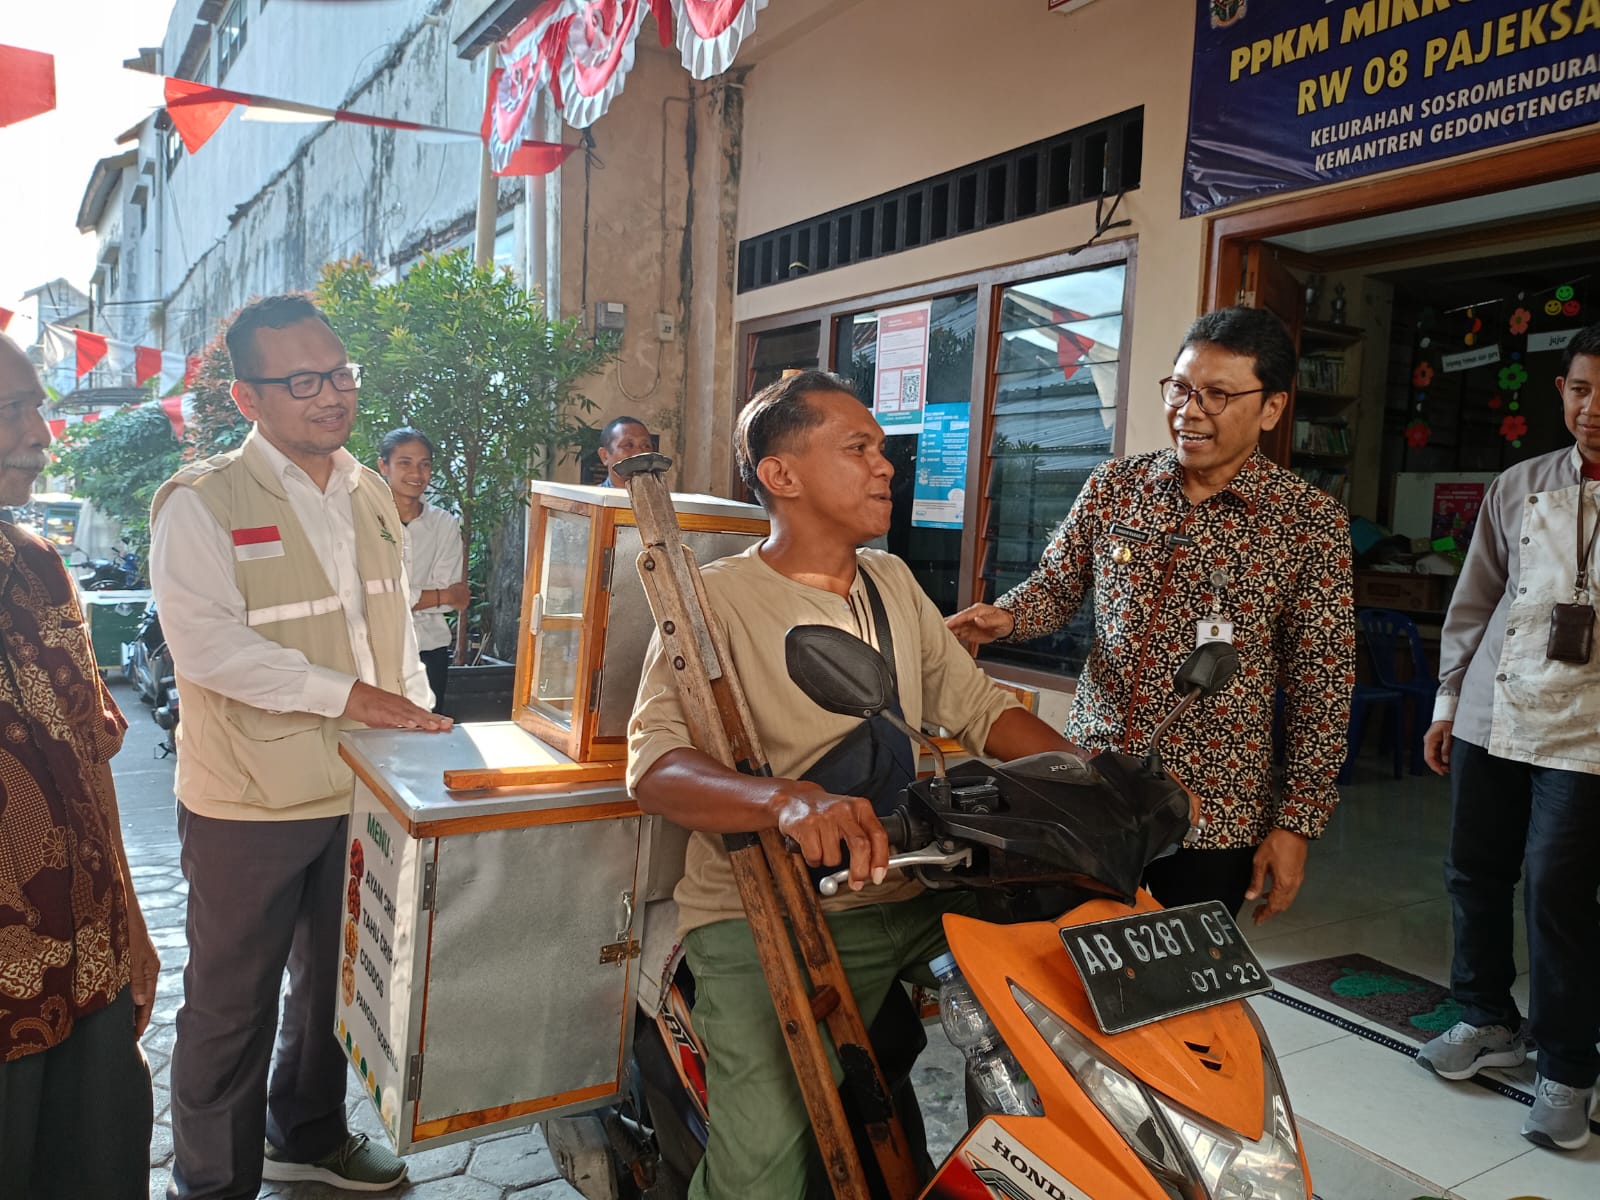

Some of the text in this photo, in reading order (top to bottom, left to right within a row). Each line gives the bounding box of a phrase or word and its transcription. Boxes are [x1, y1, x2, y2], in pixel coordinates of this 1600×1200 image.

[1229, 17, 1329, 82] PPKM
[1297, 66, 1352, 115] RW
[1363, 49, 1409, 95] 08
[1310, 53, 1600, 148] KELURAHAN SOSROMENDURA
[1315, 129, 1423, 172] KEMANTREN
[367, 812, 391, 858] MENU
[366, 869, 383, 904] AYAM
[363, 908, 380, 943] TAHU
[1077, 933, 1123, 975] AB
[1124, 918, 1195, 962] 6287
[992, 1136, 1077, 1200] HOND
